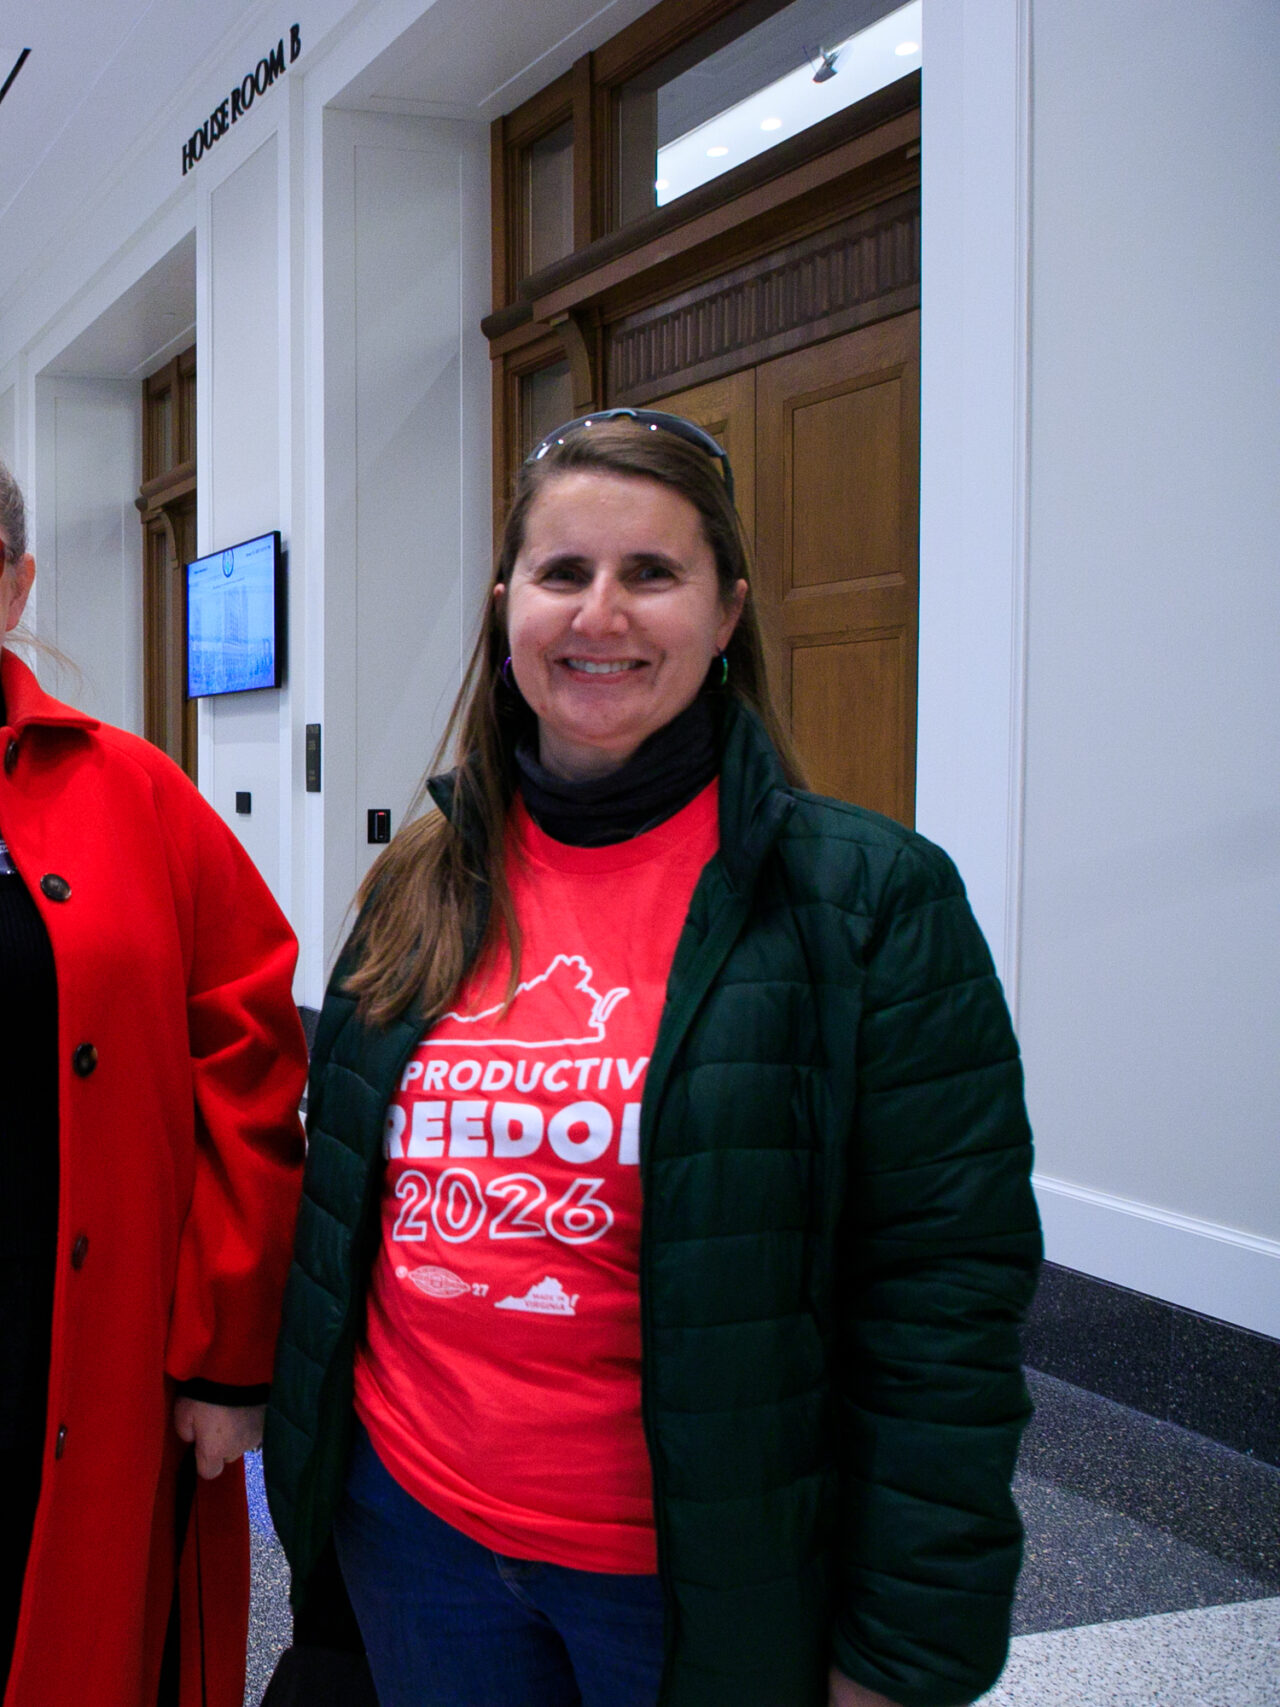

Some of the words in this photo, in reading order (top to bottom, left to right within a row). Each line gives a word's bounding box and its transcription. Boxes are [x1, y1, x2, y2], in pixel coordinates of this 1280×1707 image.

[181, 98, 230, 176] HOUSE
[231, 38, 286, 124] ROOM
[290, 23, 301, 64] B
[400, 1056, 650, 1092] PRODUCTIV
[383, 1100, 641, 1165] REEDO
[392, 1167, 614, 1245] 2026
[471, 1282, 489, 1297] 27
